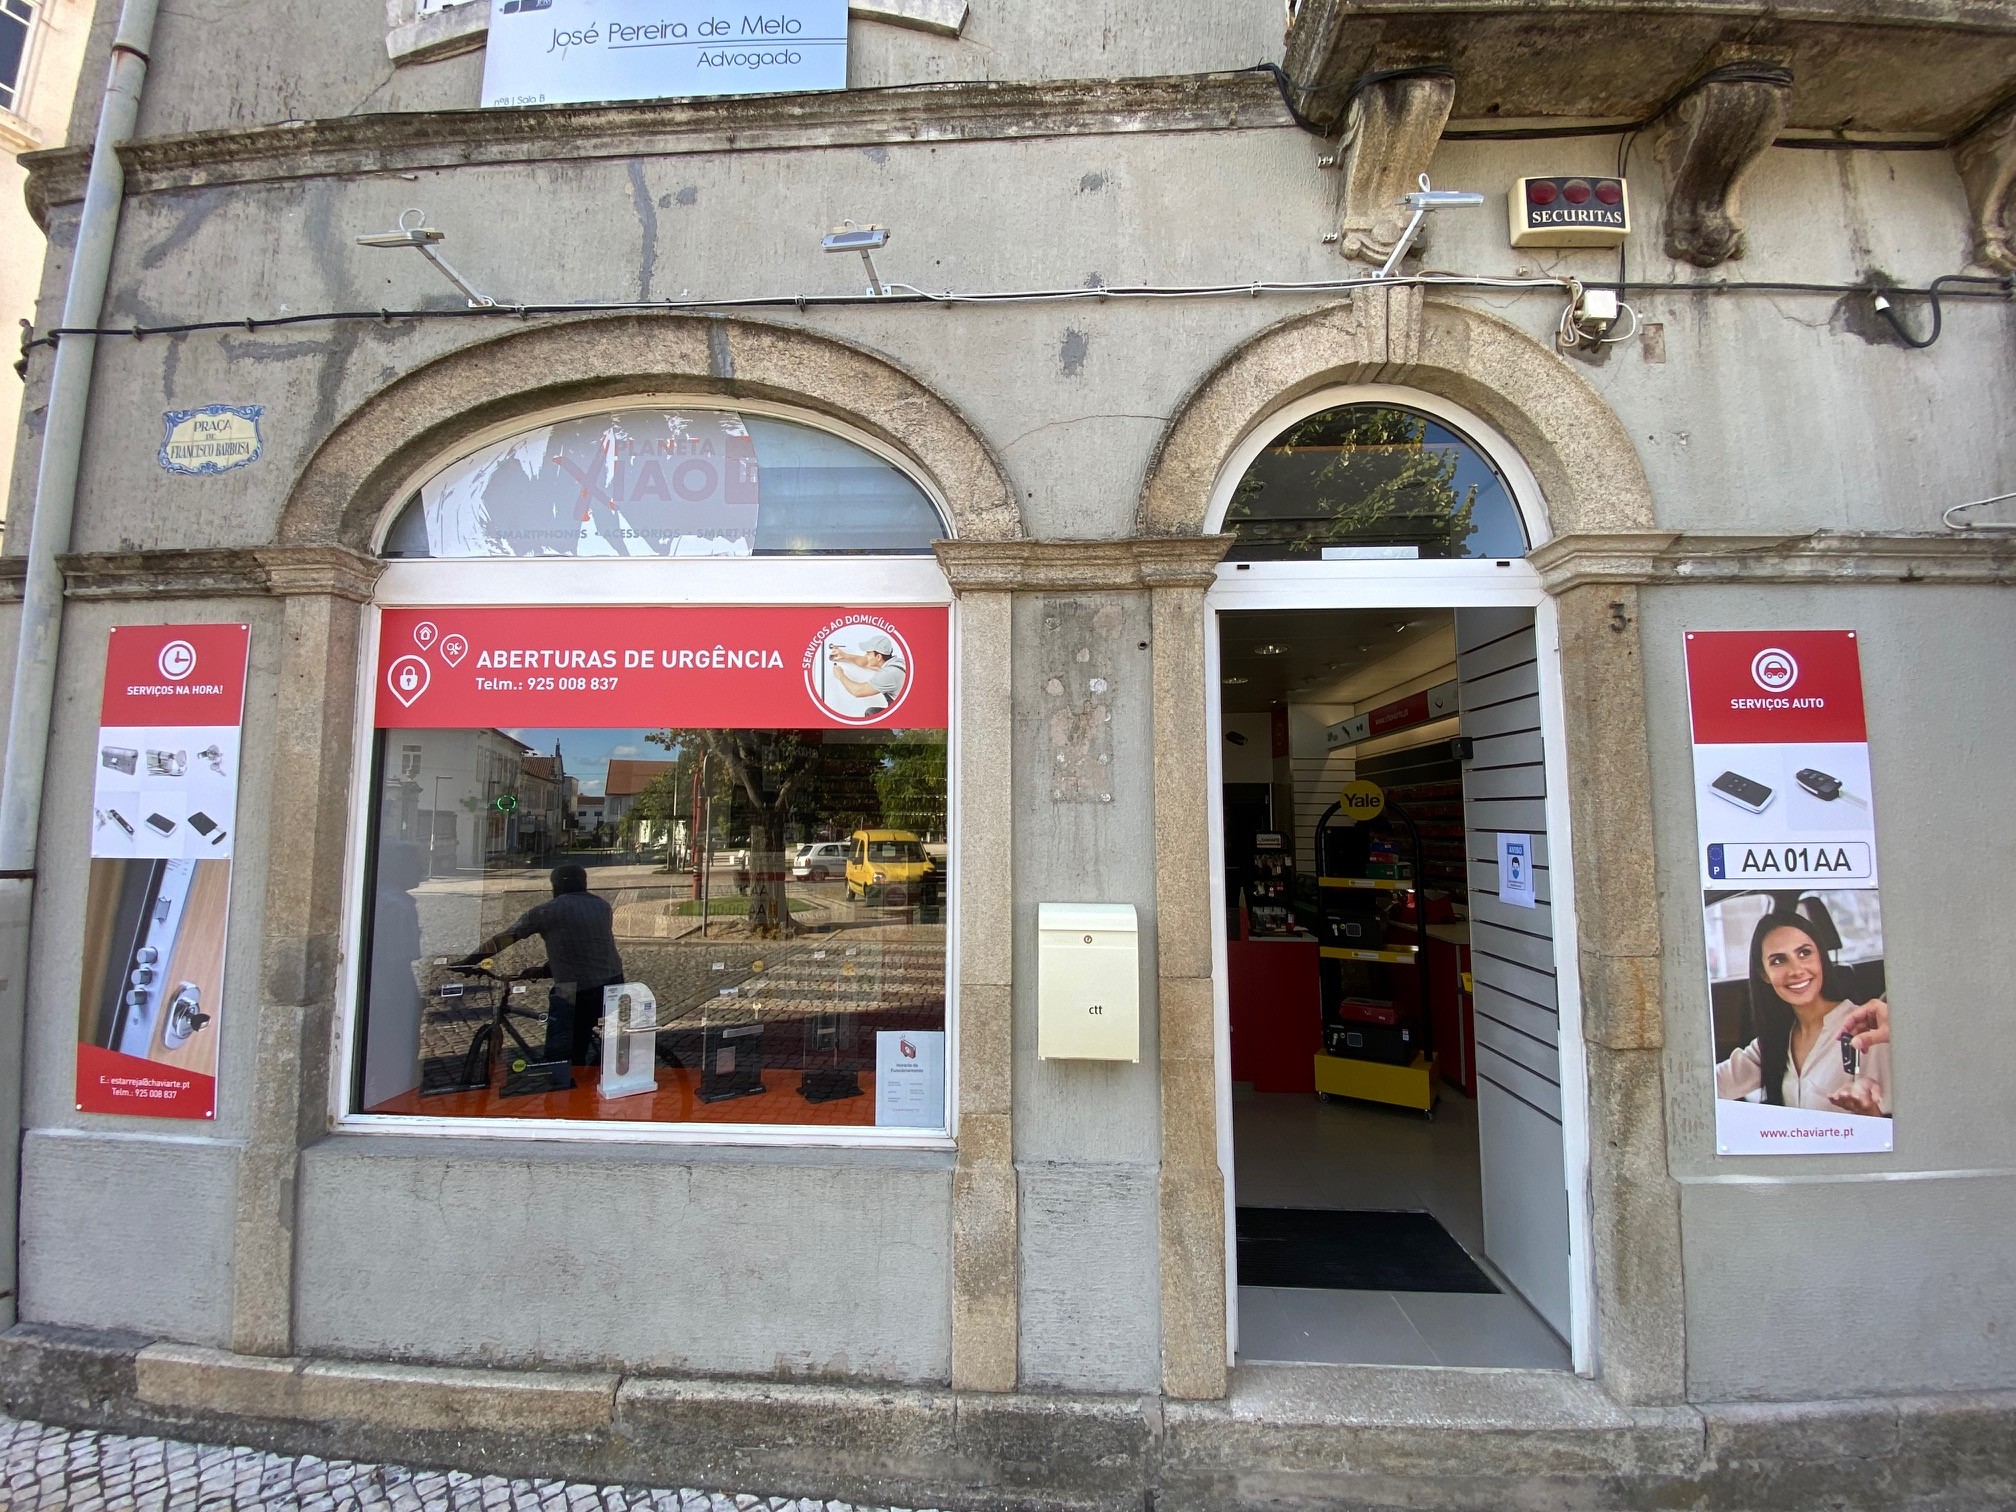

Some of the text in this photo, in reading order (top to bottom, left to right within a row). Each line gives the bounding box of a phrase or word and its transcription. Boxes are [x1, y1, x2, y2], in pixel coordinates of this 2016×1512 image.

[547, 15, 802, 53] José Pereira de Melo
[697, 49, 802, 70] Advogado
[517, 95, 537, 104] Sala
[540, 94, 546, 103] B
[1532, 209, 1622, 224] SECURITAS
[194, 420, 232, 433] PRAÇA
[170, 441, 250, 459] FRANCISCO BARBOSA
[617, 438, 717, 456] PLANETA
[496, 529, 588, 539] SMARTPHONES
[697, 528, 742, 539] SMART
[1609, 601, 1627, 634] 3
[802, 614, 896, 669] SERVIÇOS AO DOMICÍLIO
[476, 644, 784, 669] ABERTURAS DE URGÊNCIA
[127, 685, 224, 697] SERVIÇOS NA HORA!
[476, 677, 619, 691] Telm.: 925 008 837
[1730, 698, 1824, 711] SERVIÇOS AUTO
[1343, 793, 1381, 808] Yale
[1508, 846, 1523, 855] AVISO
[1713, 848, 1852, 875] P AA 01 AA
[1088, 1005, 1103, 1015] ctt
[112, 1088, 178, 1099] Telm.: 925 008 837
[1760, 1126, 1855, 1139] www.chaviarte.pt
